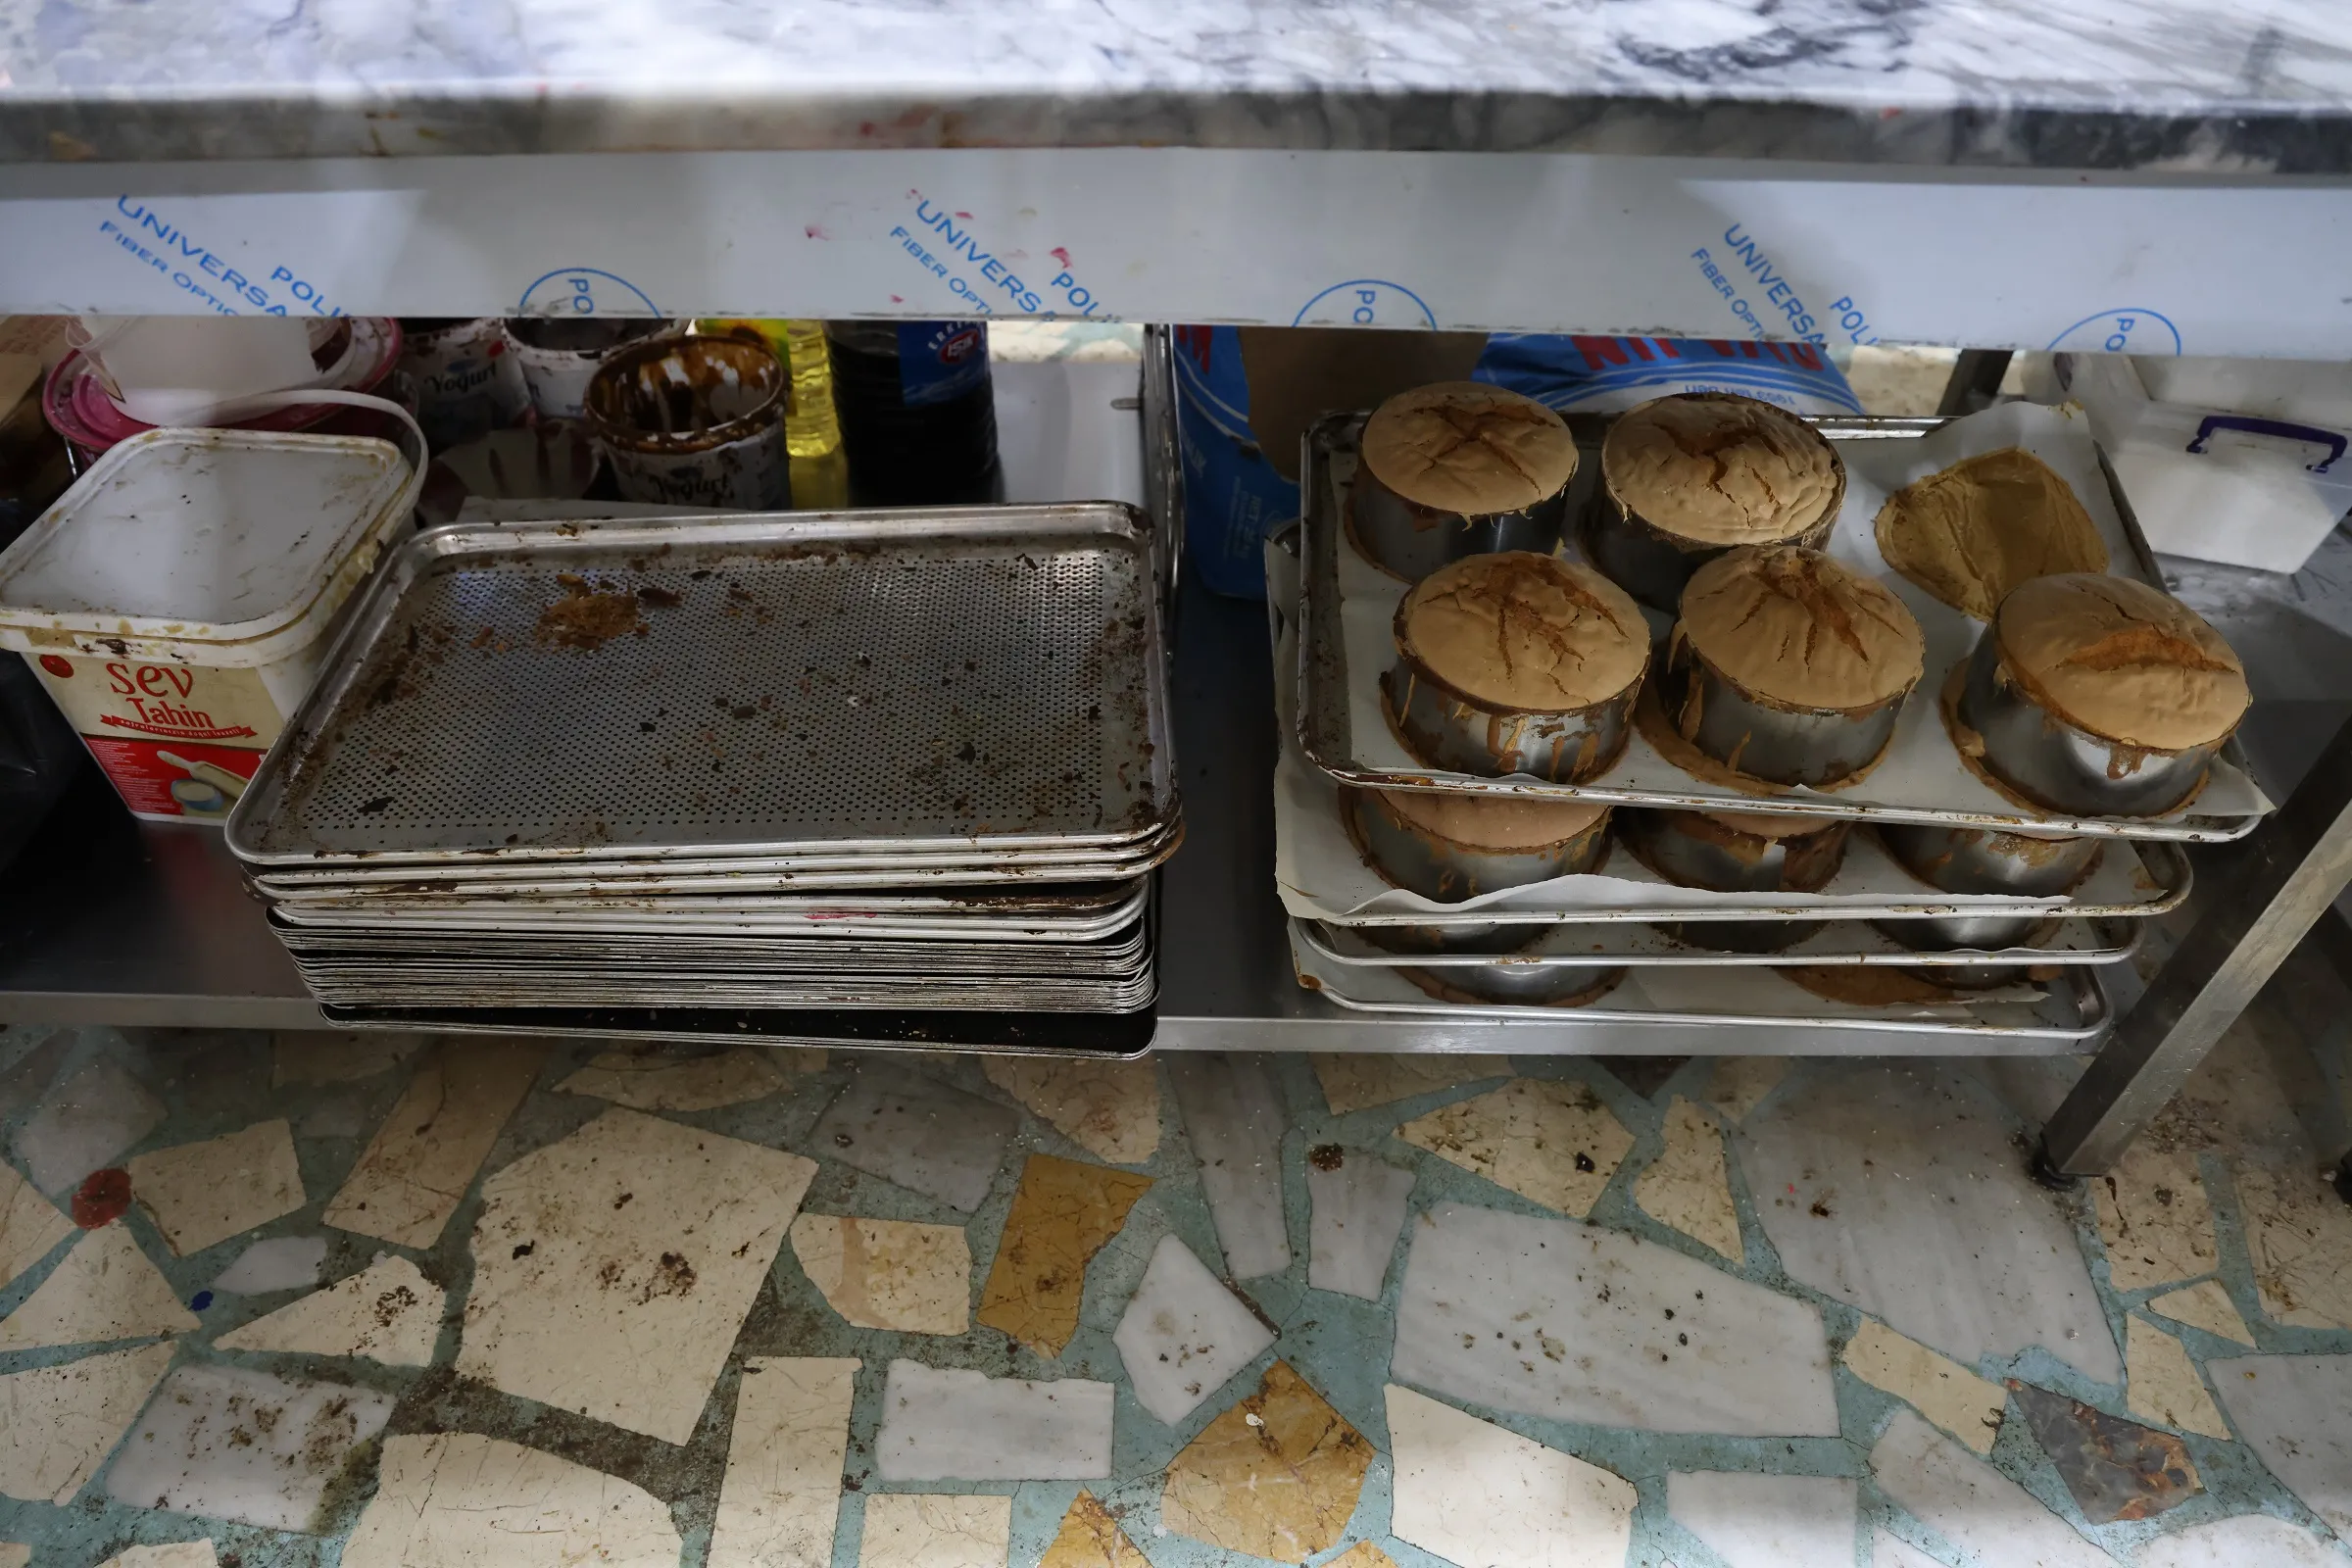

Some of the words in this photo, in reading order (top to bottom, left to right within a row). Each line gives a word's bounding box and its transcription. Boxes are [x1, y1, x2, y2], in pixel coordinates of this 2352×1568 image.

[100, 220, 168, 272] FIBER
[890, 226, 948, 277] FIBER
[1690, 248, 1735, 300] FIBER
[423, 360, 497, 393] Yogurt
[125, 697, 216, 729] Tahin
